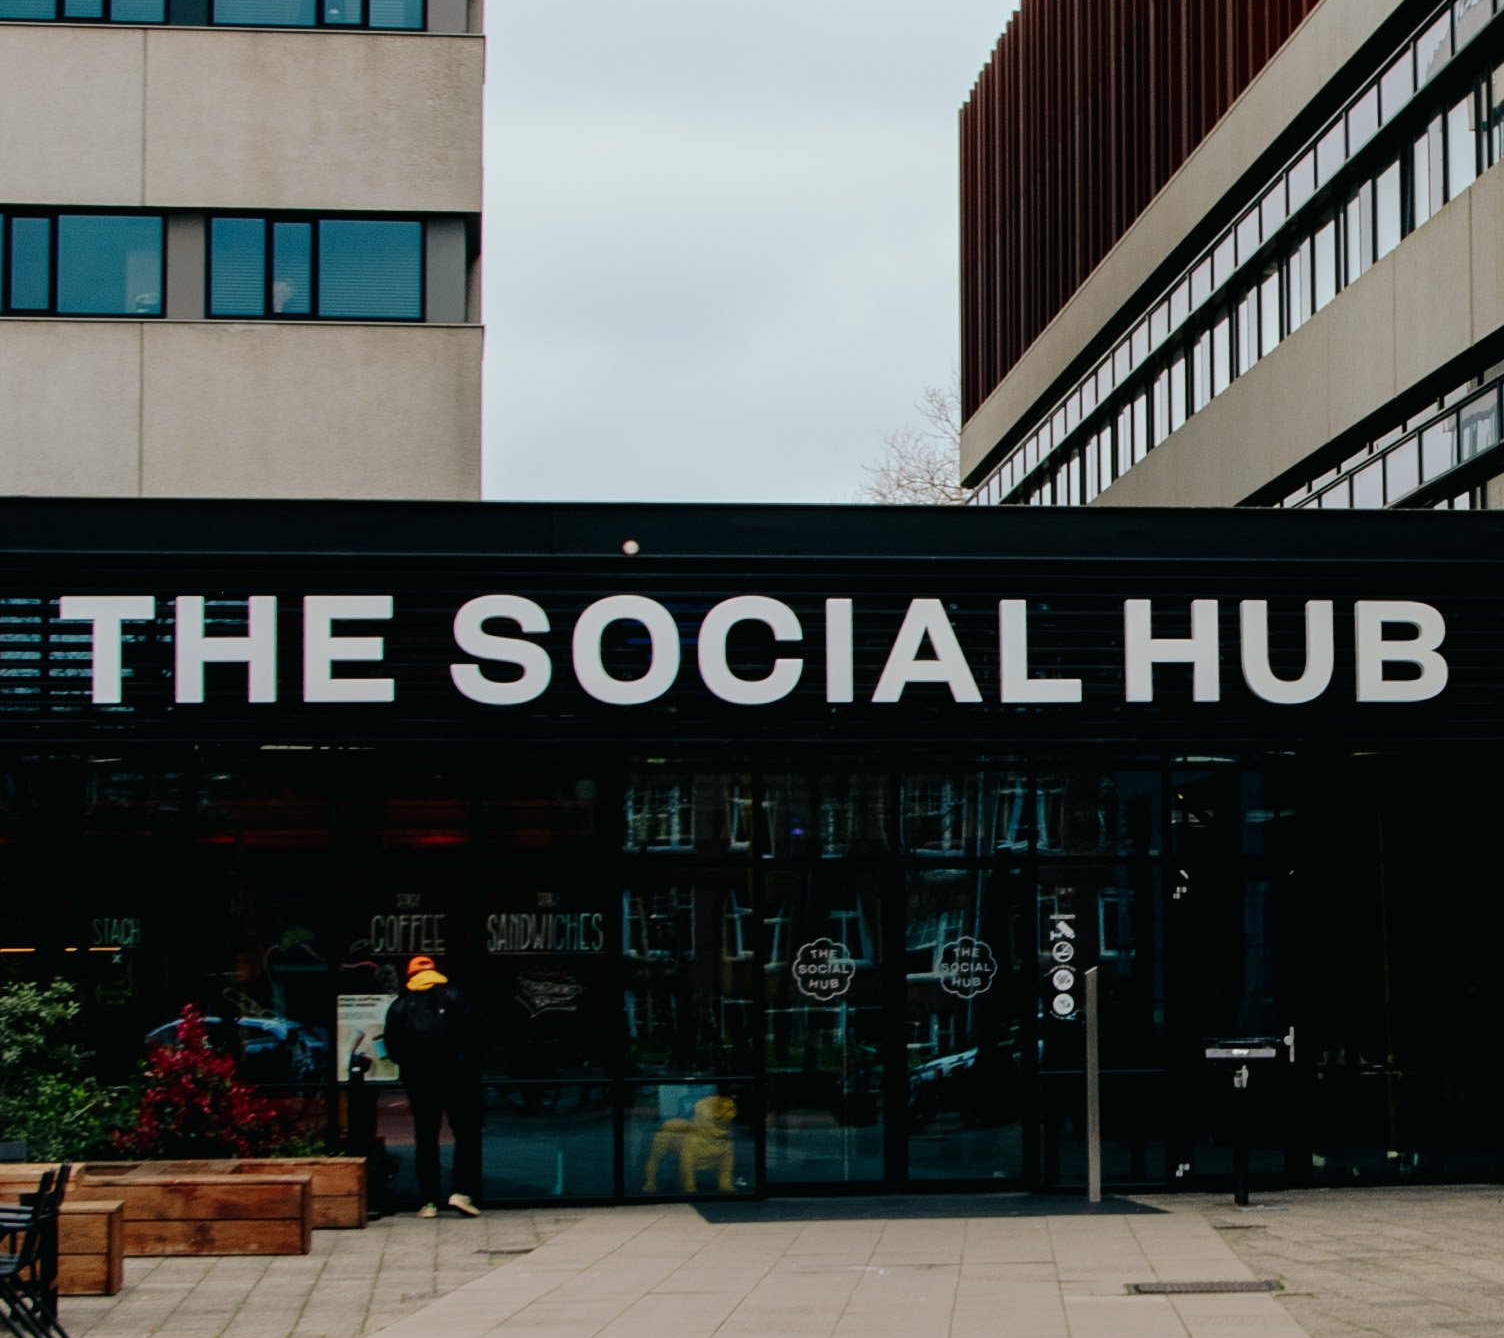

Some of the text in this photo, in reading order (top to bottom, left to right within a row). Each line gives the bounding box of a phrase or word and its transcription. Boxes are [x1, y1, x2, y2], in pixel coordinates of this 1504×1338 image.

[59, 593, 1450, 706] THE SOCIAL HUB
[91, 917, 142, 946] STACH
[370, 913, 447, 953] COFFEE
[485, 912, 605, 953] SANDWICHES
[809, 948, 839, 959] THE
[952, 947, 981, 958] THE
[797, 963, 850, 975] SOCIAL
[940, 962, 992, 974] SOCIAL
[807, 978, 840, 990] HUB
[950, 976, 983, 988] HUB
